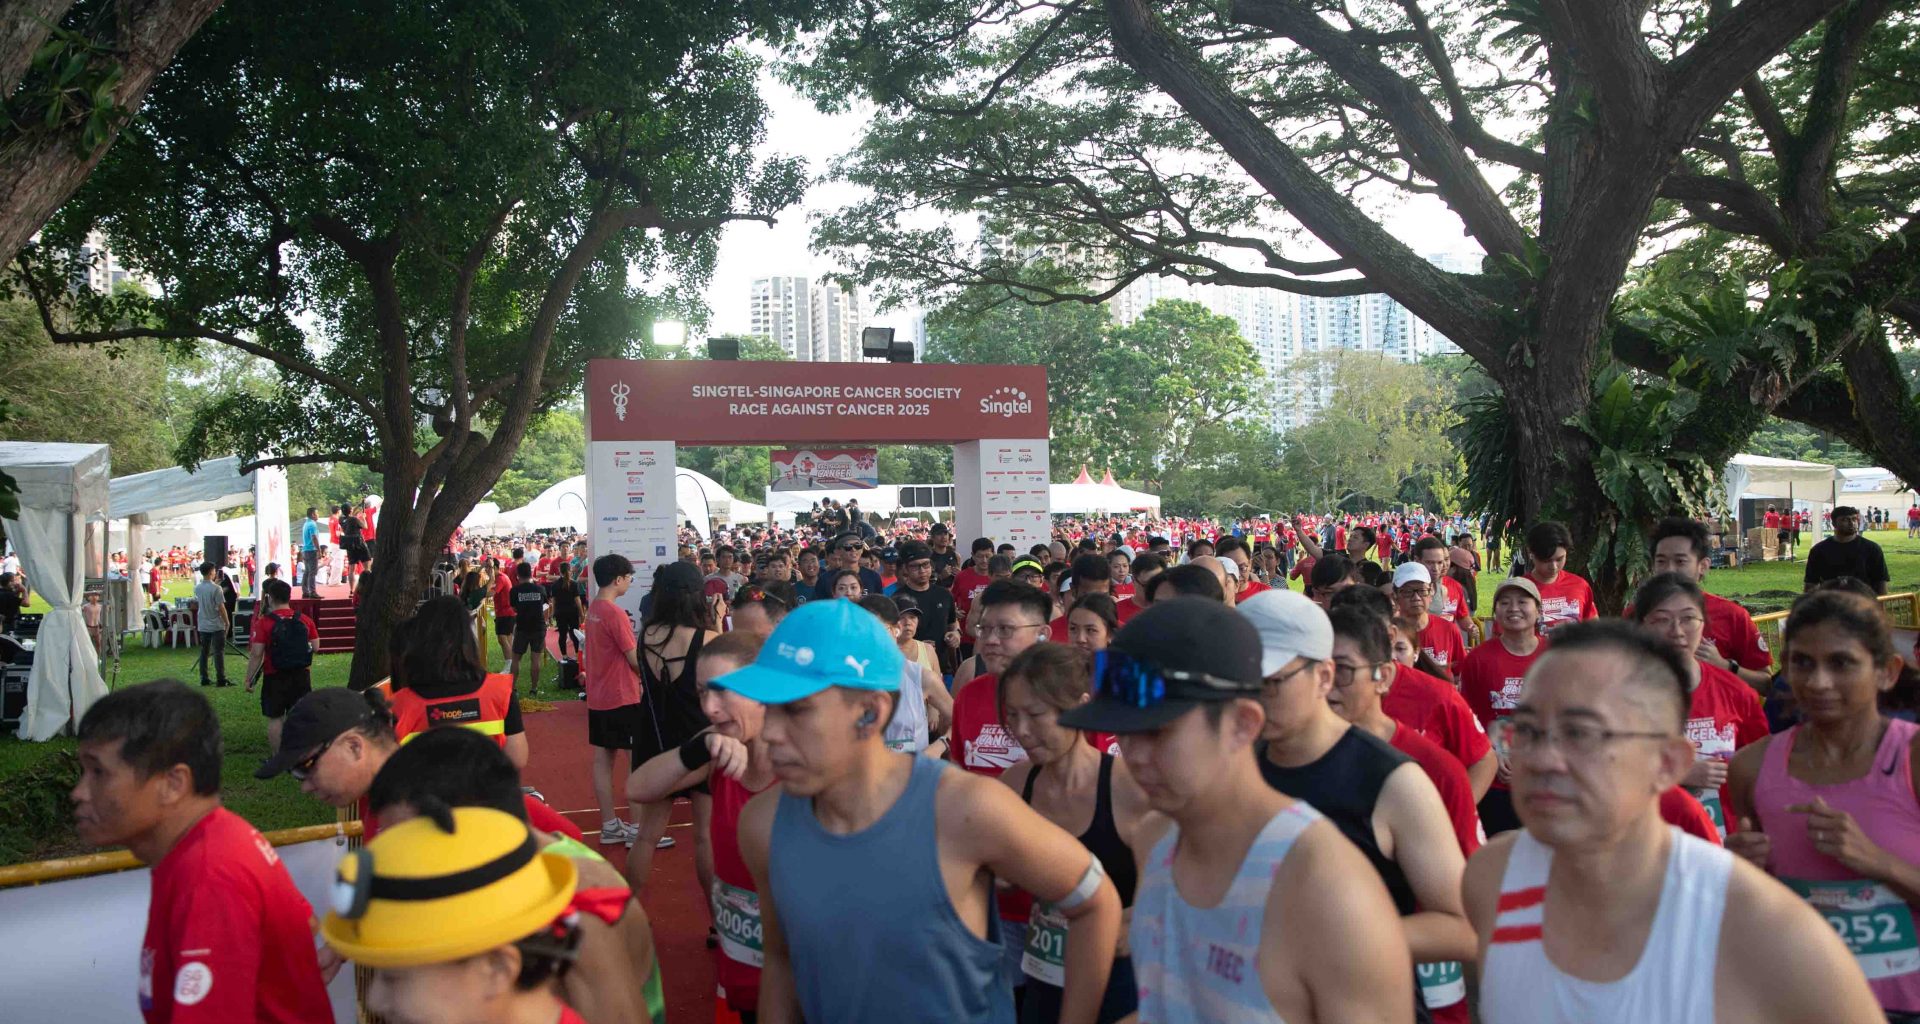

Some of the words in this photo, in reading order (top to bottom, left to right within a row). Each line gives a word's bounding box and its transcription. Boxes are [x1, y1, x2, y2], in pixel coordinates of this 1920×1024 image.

[692, 385, 840, 398] SINGTEL-SINGAPORE
[844, 386, 901, 399] CANCER
[905, 387, 961, 399] SOCIETY
[729, 403, 768, 415] RACE
[771, 403, 833, 415] AGAINST
[836, 403, 895, 415] CANCER
[898, 404, 930, 415] 2025
[980, 395, 1031, 417] Singtel
[716, 903, 763, 943] 20064
[1206, 943, 1245, 985] TREC
